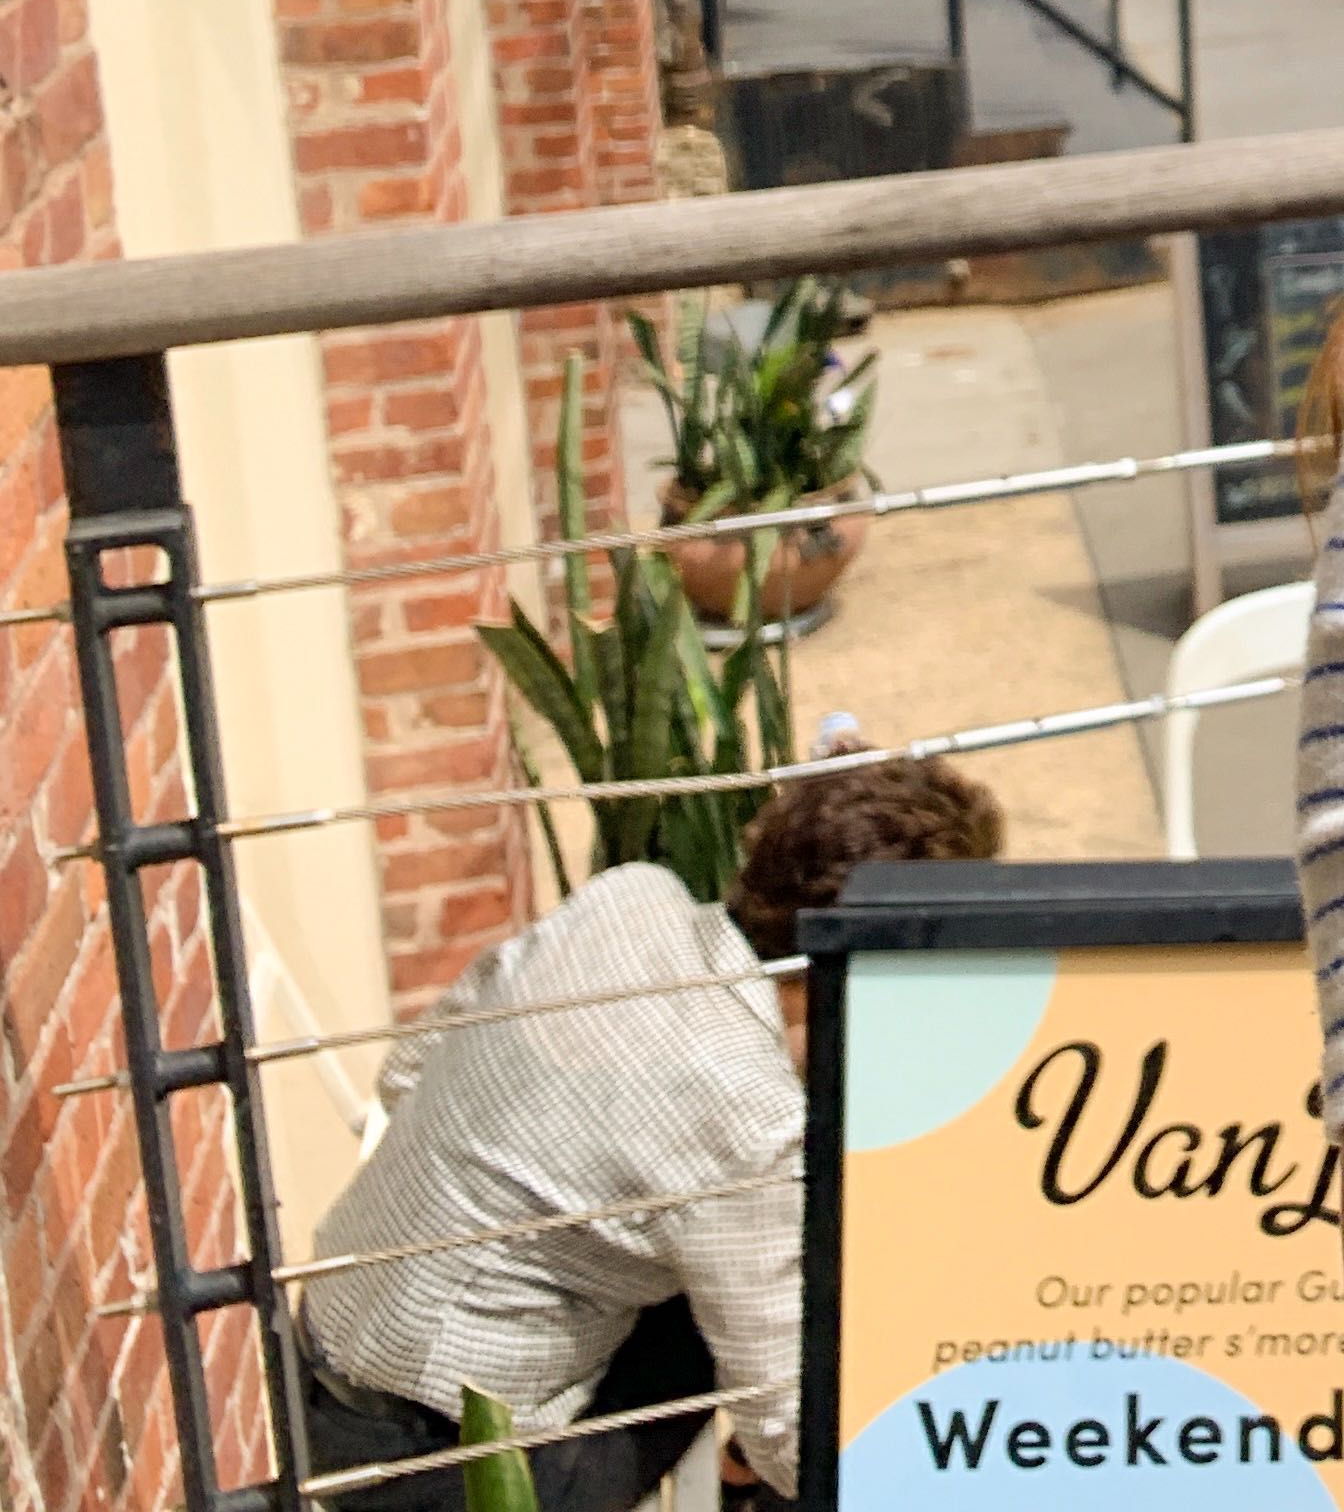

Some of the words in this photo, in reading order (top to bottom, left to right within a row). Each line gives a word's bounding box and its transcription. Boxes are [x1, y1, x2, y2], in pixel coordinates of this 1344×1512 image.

[1036, 1275, 1113, 1310] Our
[1121, 1270, 1284, 1317] popular
[932, 1330, 1078, 1372] peanut
[1088, 1326, 1213, 1363] butter
[917, 1388, 1344, 1473] Weekend
